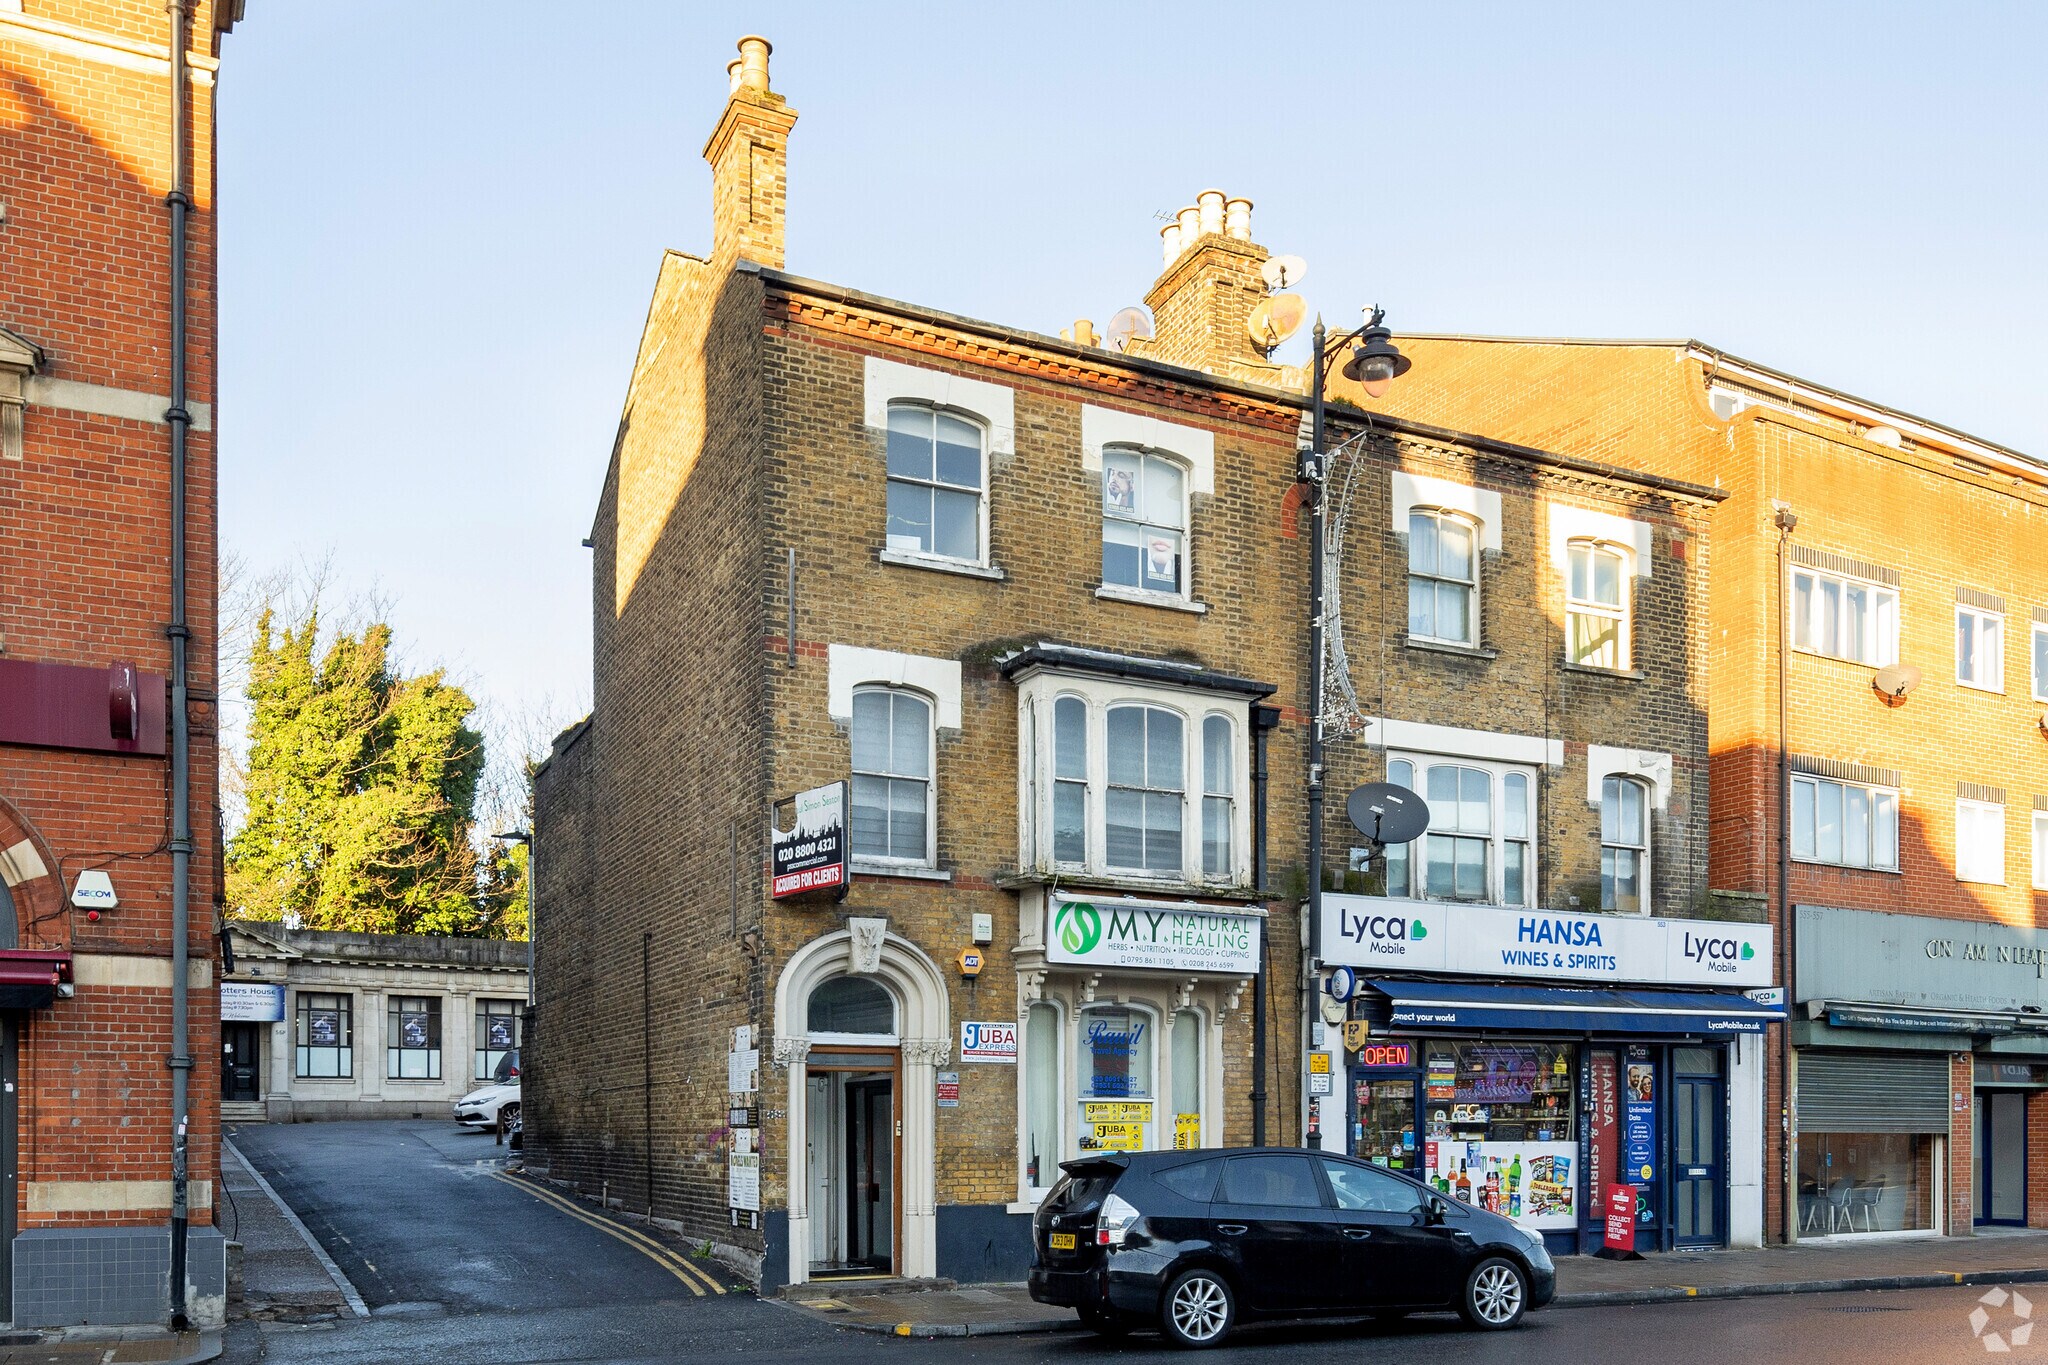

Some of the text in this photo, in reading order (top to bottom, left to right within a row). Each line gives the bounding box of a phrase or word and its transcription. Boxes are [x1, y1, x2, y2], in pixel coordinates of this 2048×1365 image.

[778, 836, 836, 862] 020 8800 4321
[775, 867, 839, 893] ACQUIRED FOR CLIENTS
[78, 890, 111, 898] SECOM
[1172, 914, 1250, 934] NATURAL
[1341, 908, 1406, 943] Lyca
[1518, 918, 1602, 947] HANSA
[1172, 930, 1249, 950] HEALING
[1108, 943, 1250, 959] HERBS NUTRITION IRIDOLOGY CUPPING
[1369, 941, 1406, 955] Mobile
[1684, 932, 1737, 963] Lyca
[965, 956, 979, 966] ADT
[1127, 956, 1234, 969] 0795 861 1105 0208 245 6599
[1501, 950, 1616, 971] WINES & SPIRITS
[1708, 961, 1737, 973] Mobile
[1751, 992, 1770, 1001] Lyca
[1416, 1014, 1434, 1023] your
[1435, 1013, 1456, 1022] world
[1708, 1021, 1760, 1030] LycaMobile.co.uk
[964, 1024, 1015, 1049] JUBA
[979, 1044, 1016, 1052] EXPRESS
[1365, 1046, 1407, 1065] OPEN
[1602, 1065, 1614, 1127] HANSA
[1088, 1104, 1108, 1114] JUBA
[1121, 1104, 1141, 1113] JUBA
[1096, 1125, 1126, 1138] JUBA
[1614, 1203, 1627, 1212] Shop
[1608, 1214, 1631, 1224] COLLECT
[1608, 1220, 1622, 1228] SEND
[1608, 1226, 1628, 1235] RETURN
